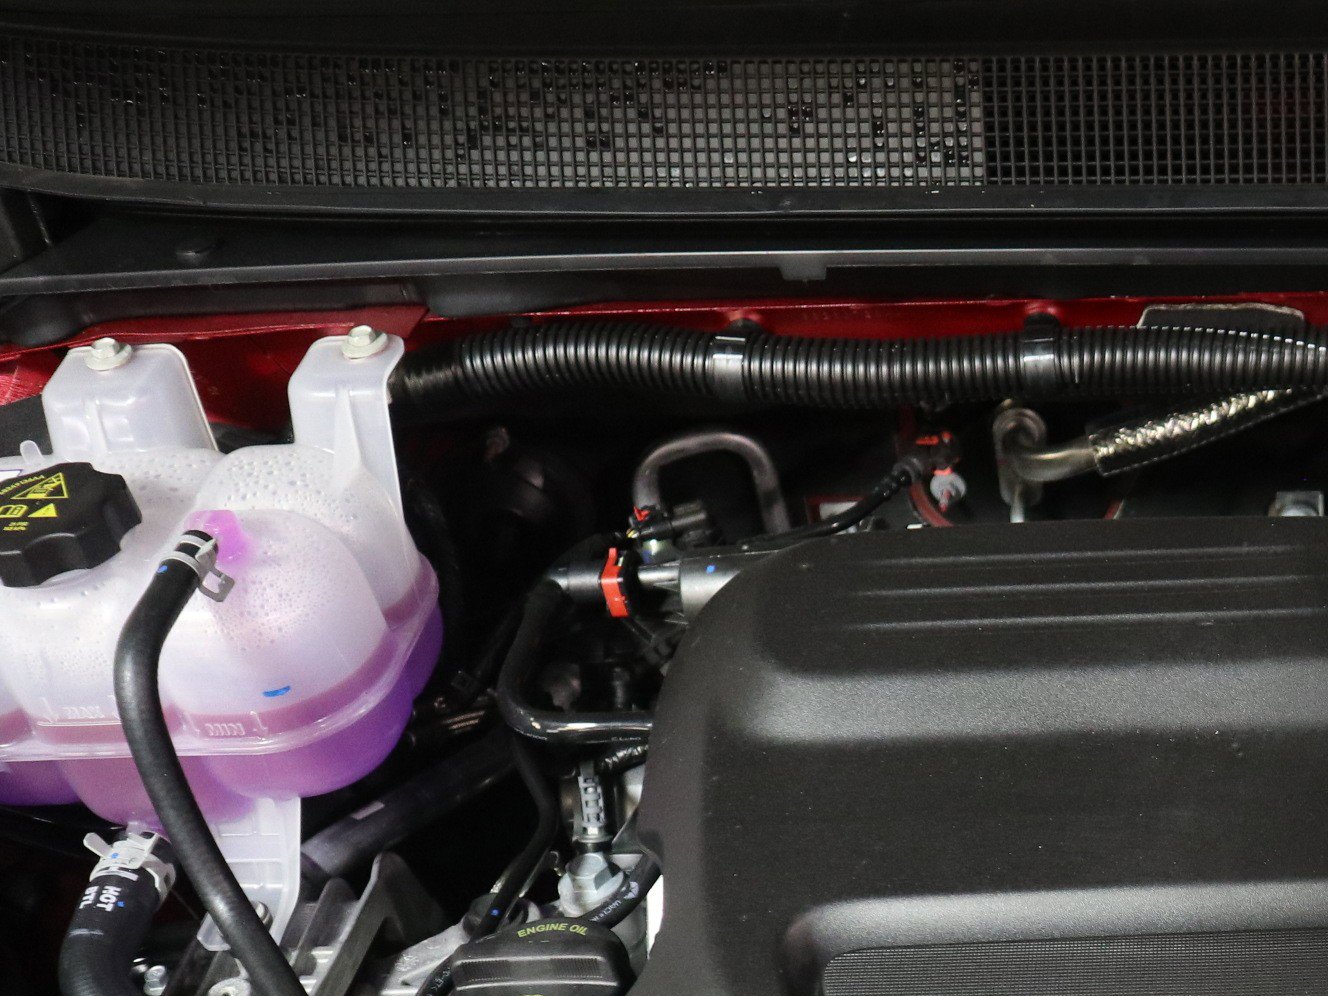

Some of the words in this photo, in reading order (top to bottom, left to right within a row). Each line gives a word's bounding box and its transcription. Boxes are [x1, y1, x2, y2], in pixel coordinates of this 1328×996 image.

[96, 885, 122, 912] HOT
[517, 923, 568, 938] ENGINE
[569, 924, 588, 936] OIL
